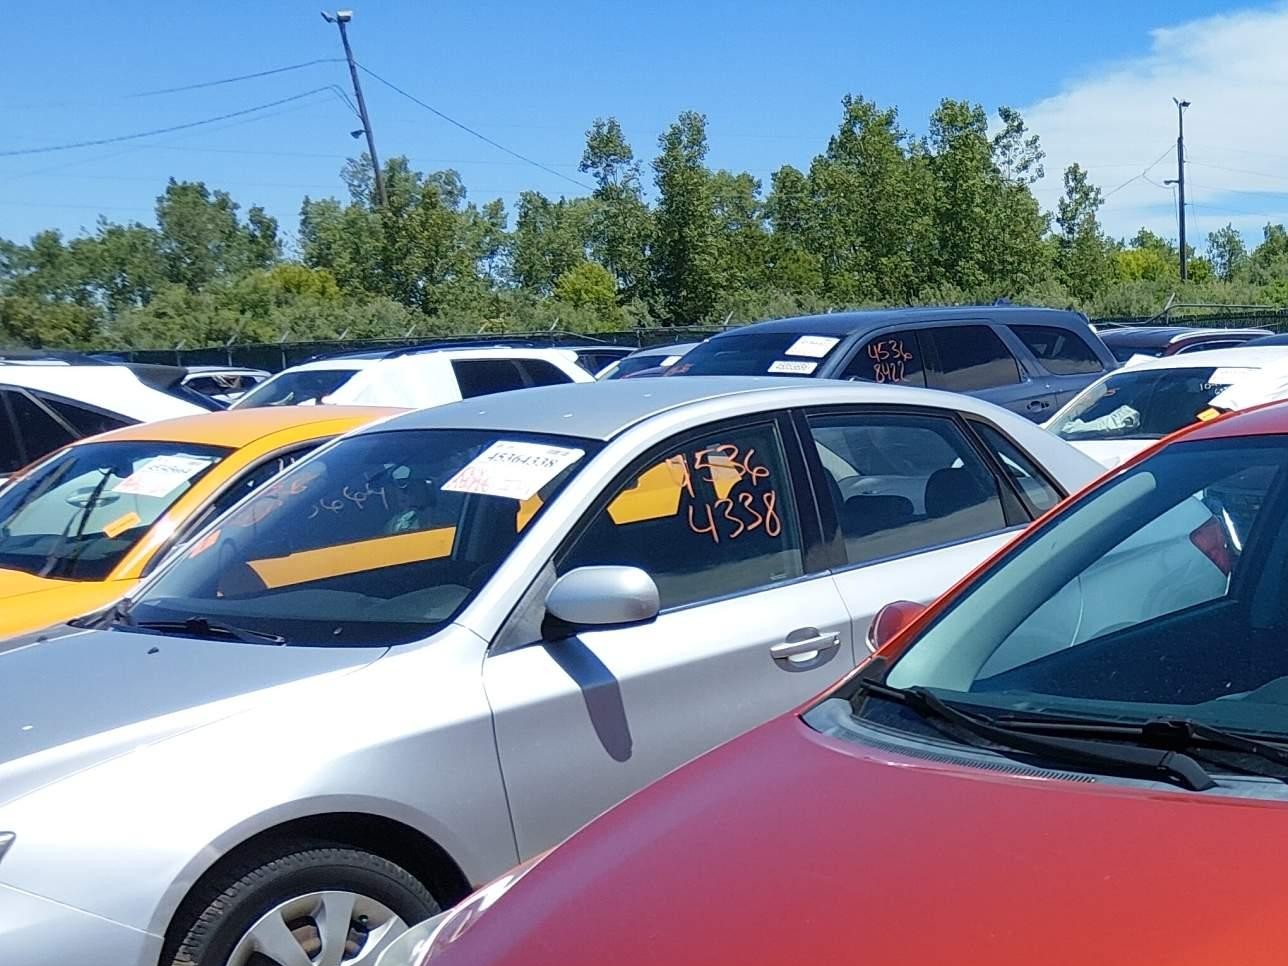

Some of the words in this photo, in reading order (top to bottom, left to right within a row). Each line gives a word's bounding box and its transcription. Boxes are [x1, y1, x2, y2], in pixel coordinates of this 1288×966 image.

[867, 340, 913, 363] 4536
[873, 361, 908, 384] 8422
[487, 451, 559, 468] 45364338
[688, 490, 781, 544] 4338
